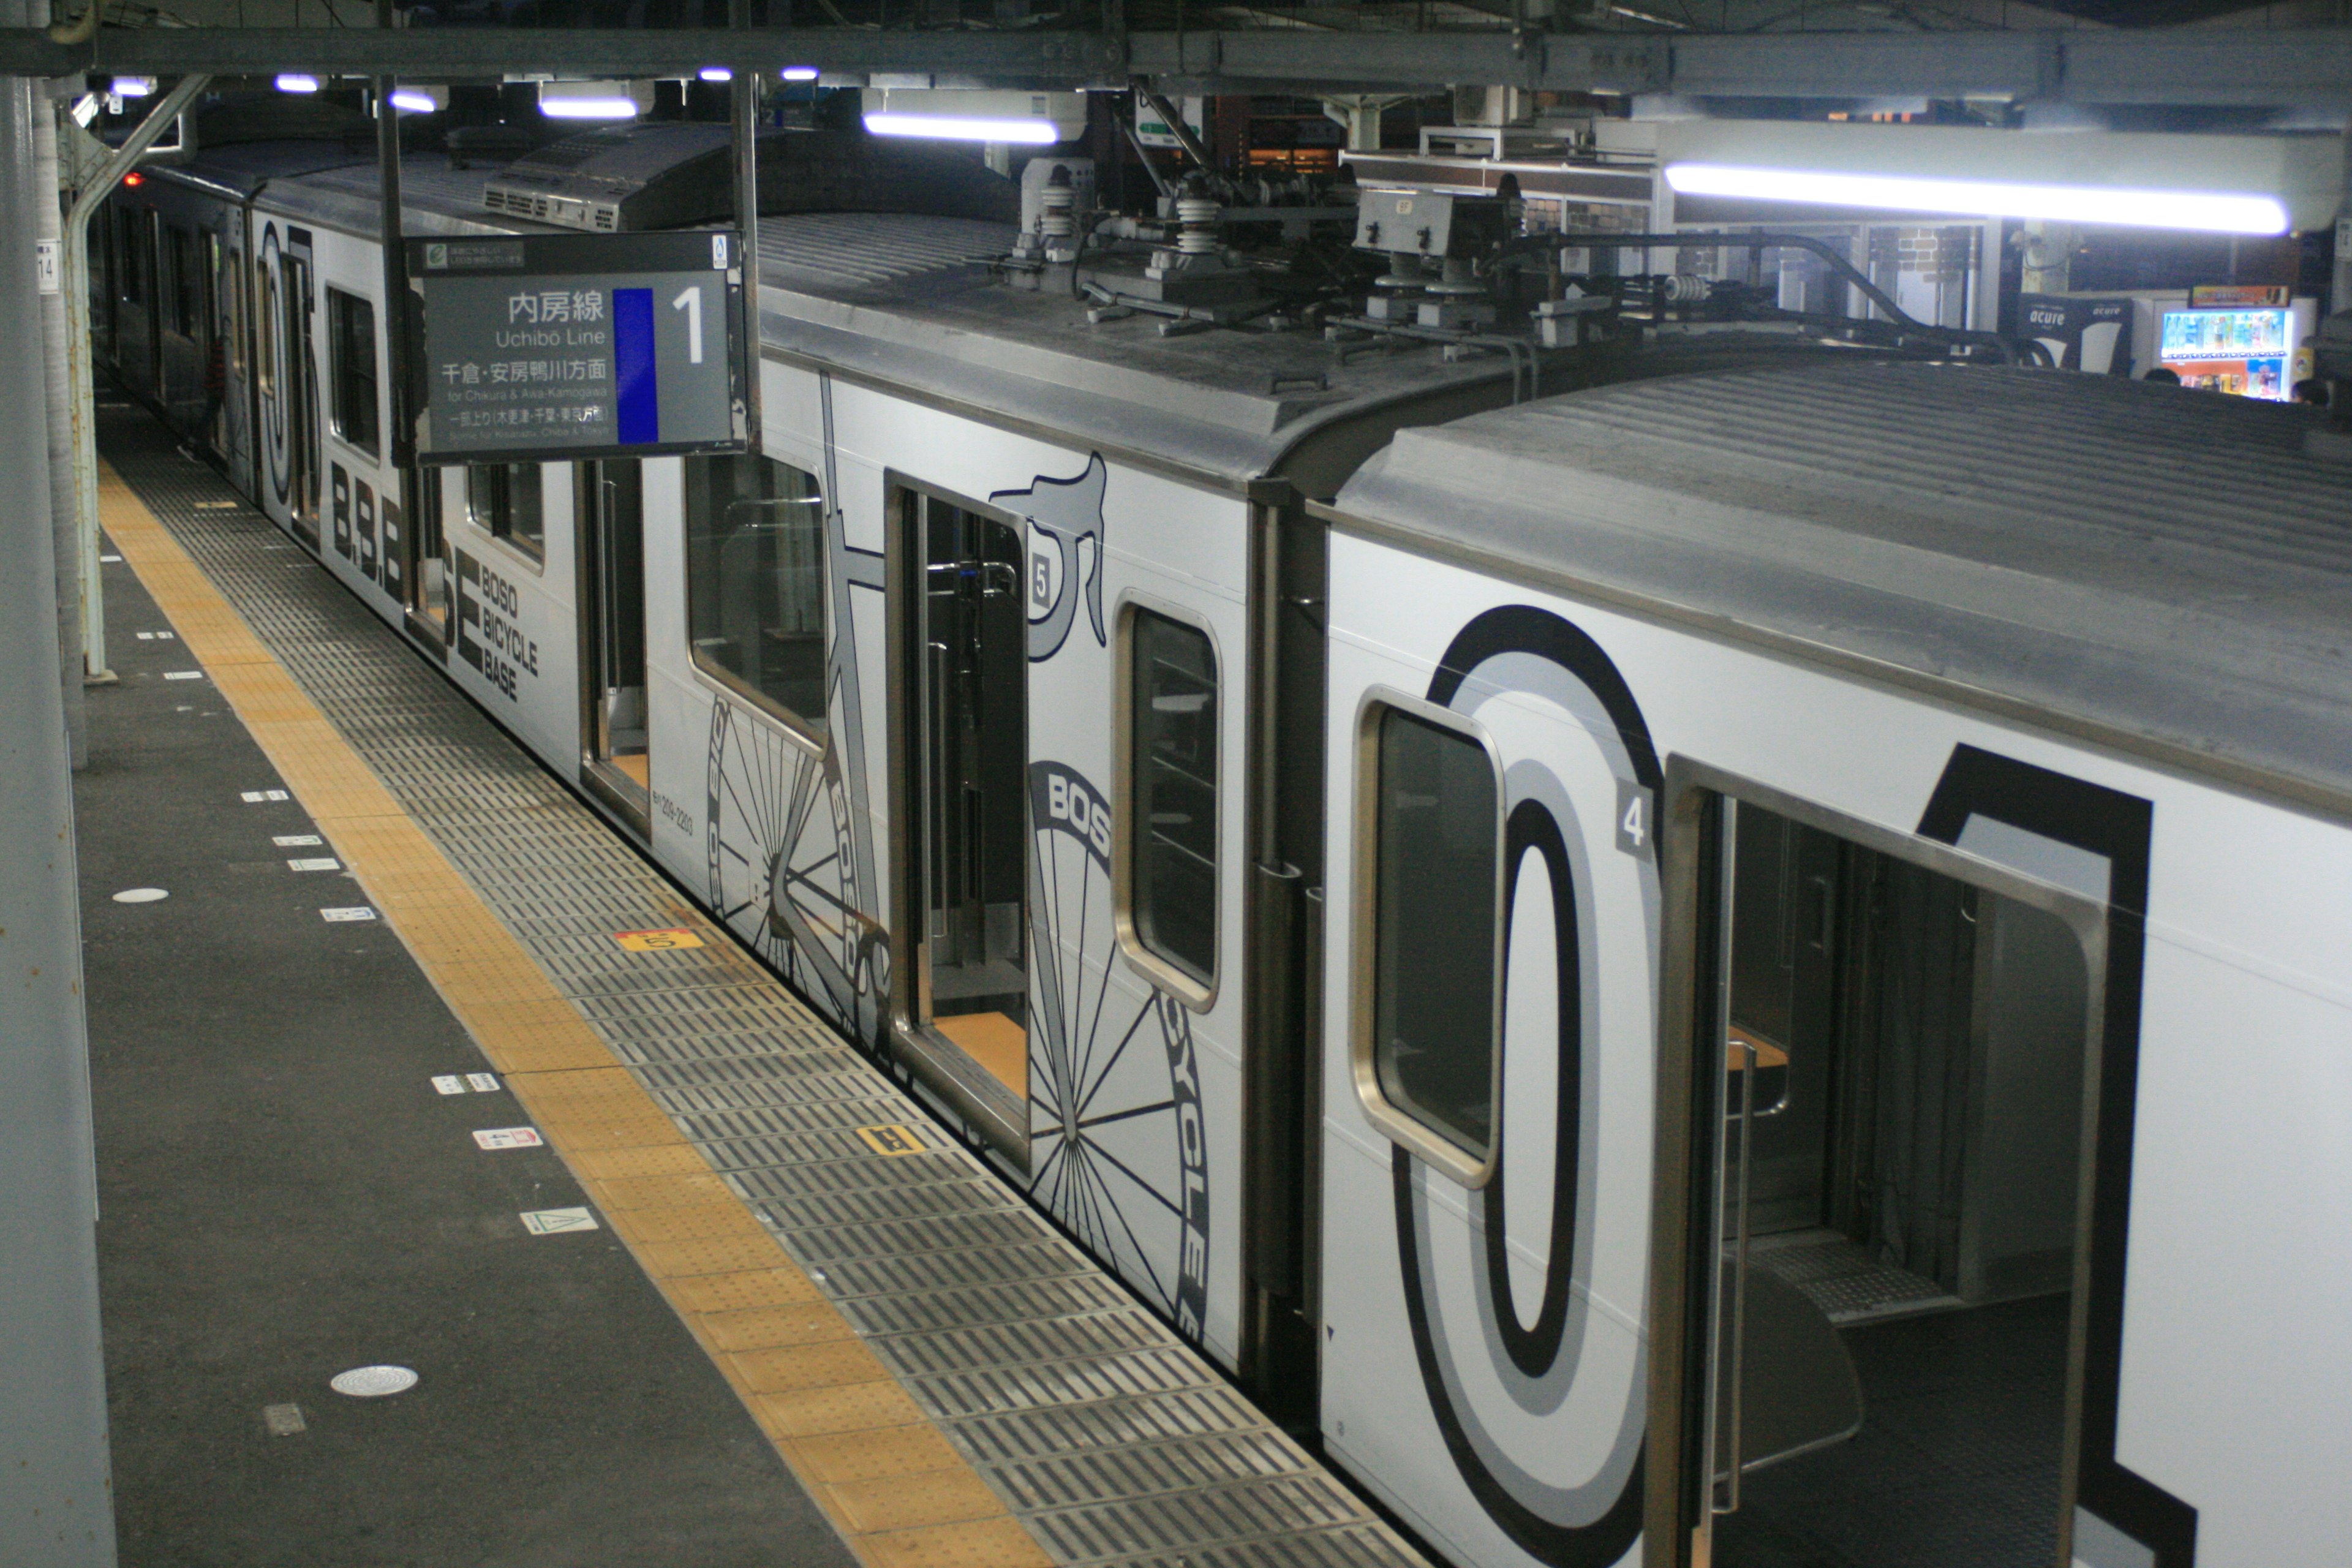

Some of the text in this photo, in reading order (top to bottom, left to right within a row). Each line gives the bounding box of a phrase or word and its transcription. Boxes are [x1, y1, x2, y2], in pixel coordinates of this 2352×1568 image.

[39, 259, 51, 279] 14
[509, 290, 603, 323] 内房線
[2030, 311, 2065, 325] acure
[567, 328, 605, 345] Line
[673, 287, 703, 364] 1
[448, 387, 608, 402] for Chikura & Awa-Kamogawa
[482, 565, 518, 619] BOSO
[1036, 562, 1046, 598] 5
[483, 606, 538, 678] BICYCLE
[484, 649, 518, 703] BASE
[1624, 796, 1644, 846] 4
